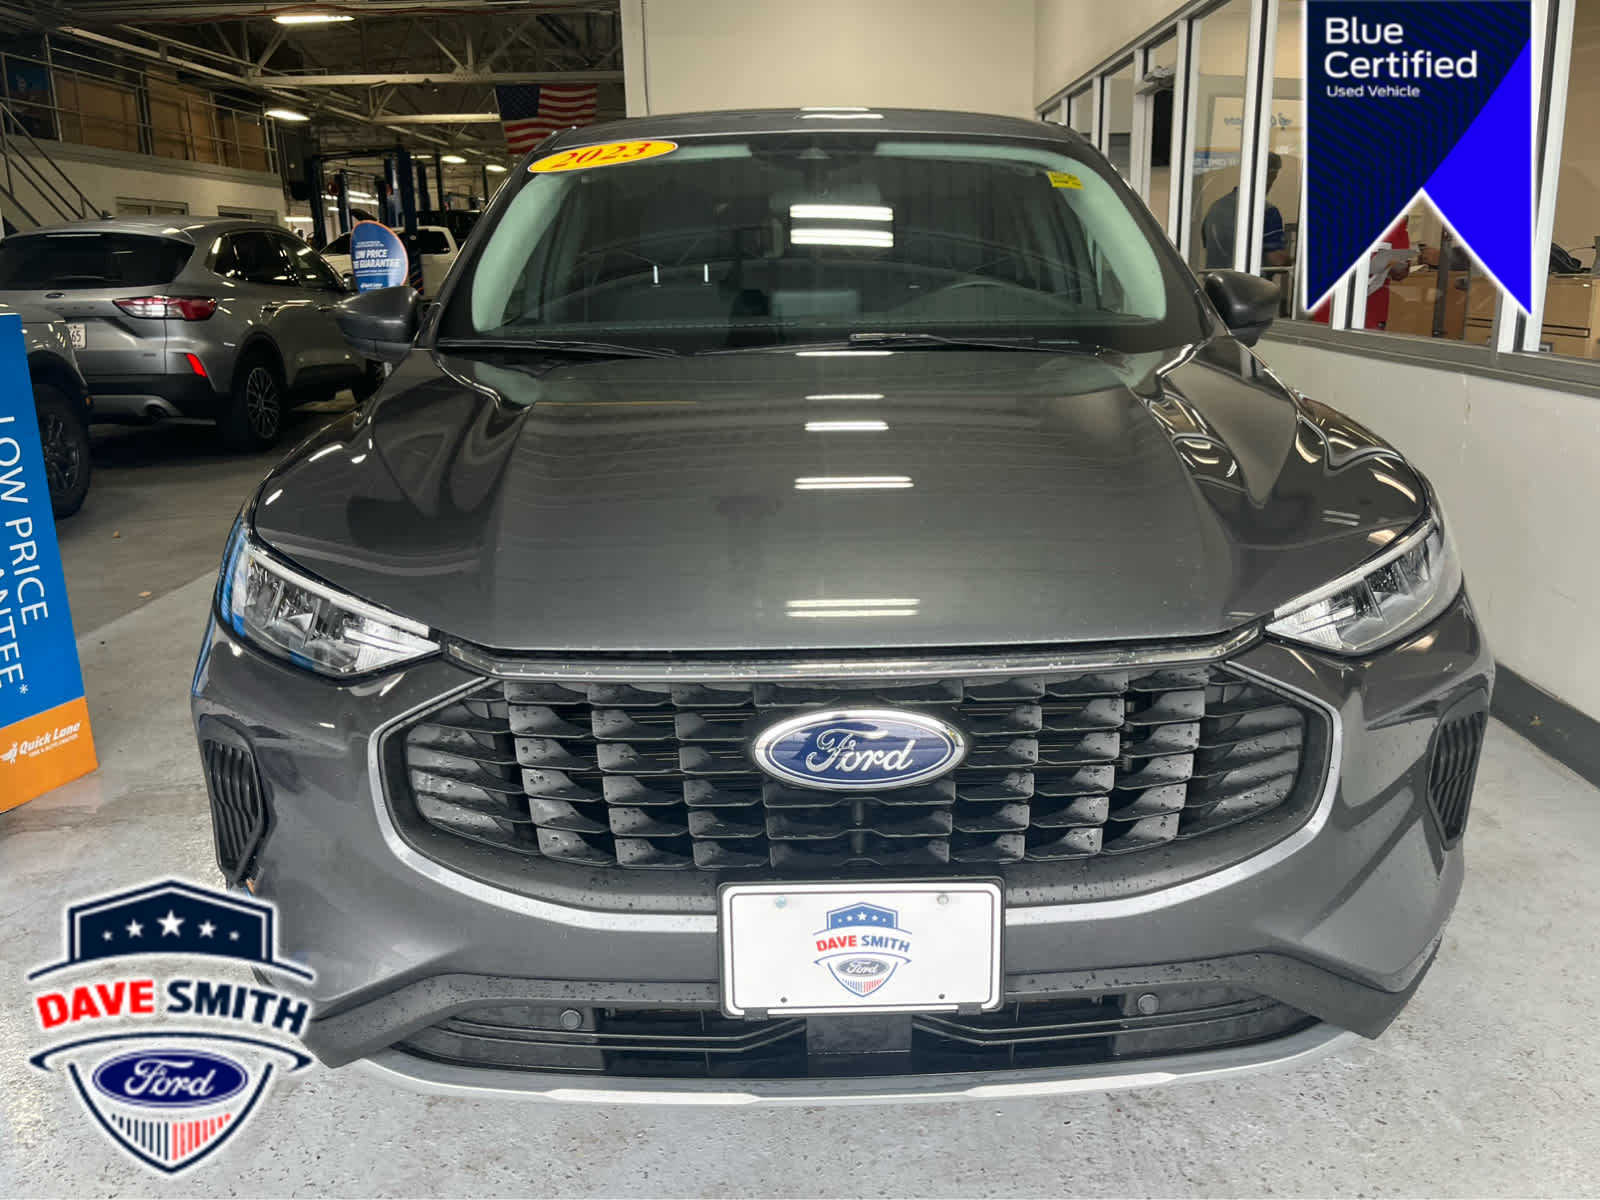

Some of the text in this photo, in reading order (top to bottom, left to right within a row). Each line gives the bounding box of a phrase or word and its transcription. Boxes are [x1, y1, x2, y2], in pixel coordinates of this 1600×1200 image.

[552, 143, 652, 169] 2023
[366, 249, 388, 258] PRICE
[5, 517, 48, 625] PRICE
[19, 732, 51, 755] Quick
[53, 722, 81, 740] Lane
[805, 728, 916, 772] Ford
[816, 935, 910, 952] DAVE SMITH
[846, 960, 880, 975] Ford
